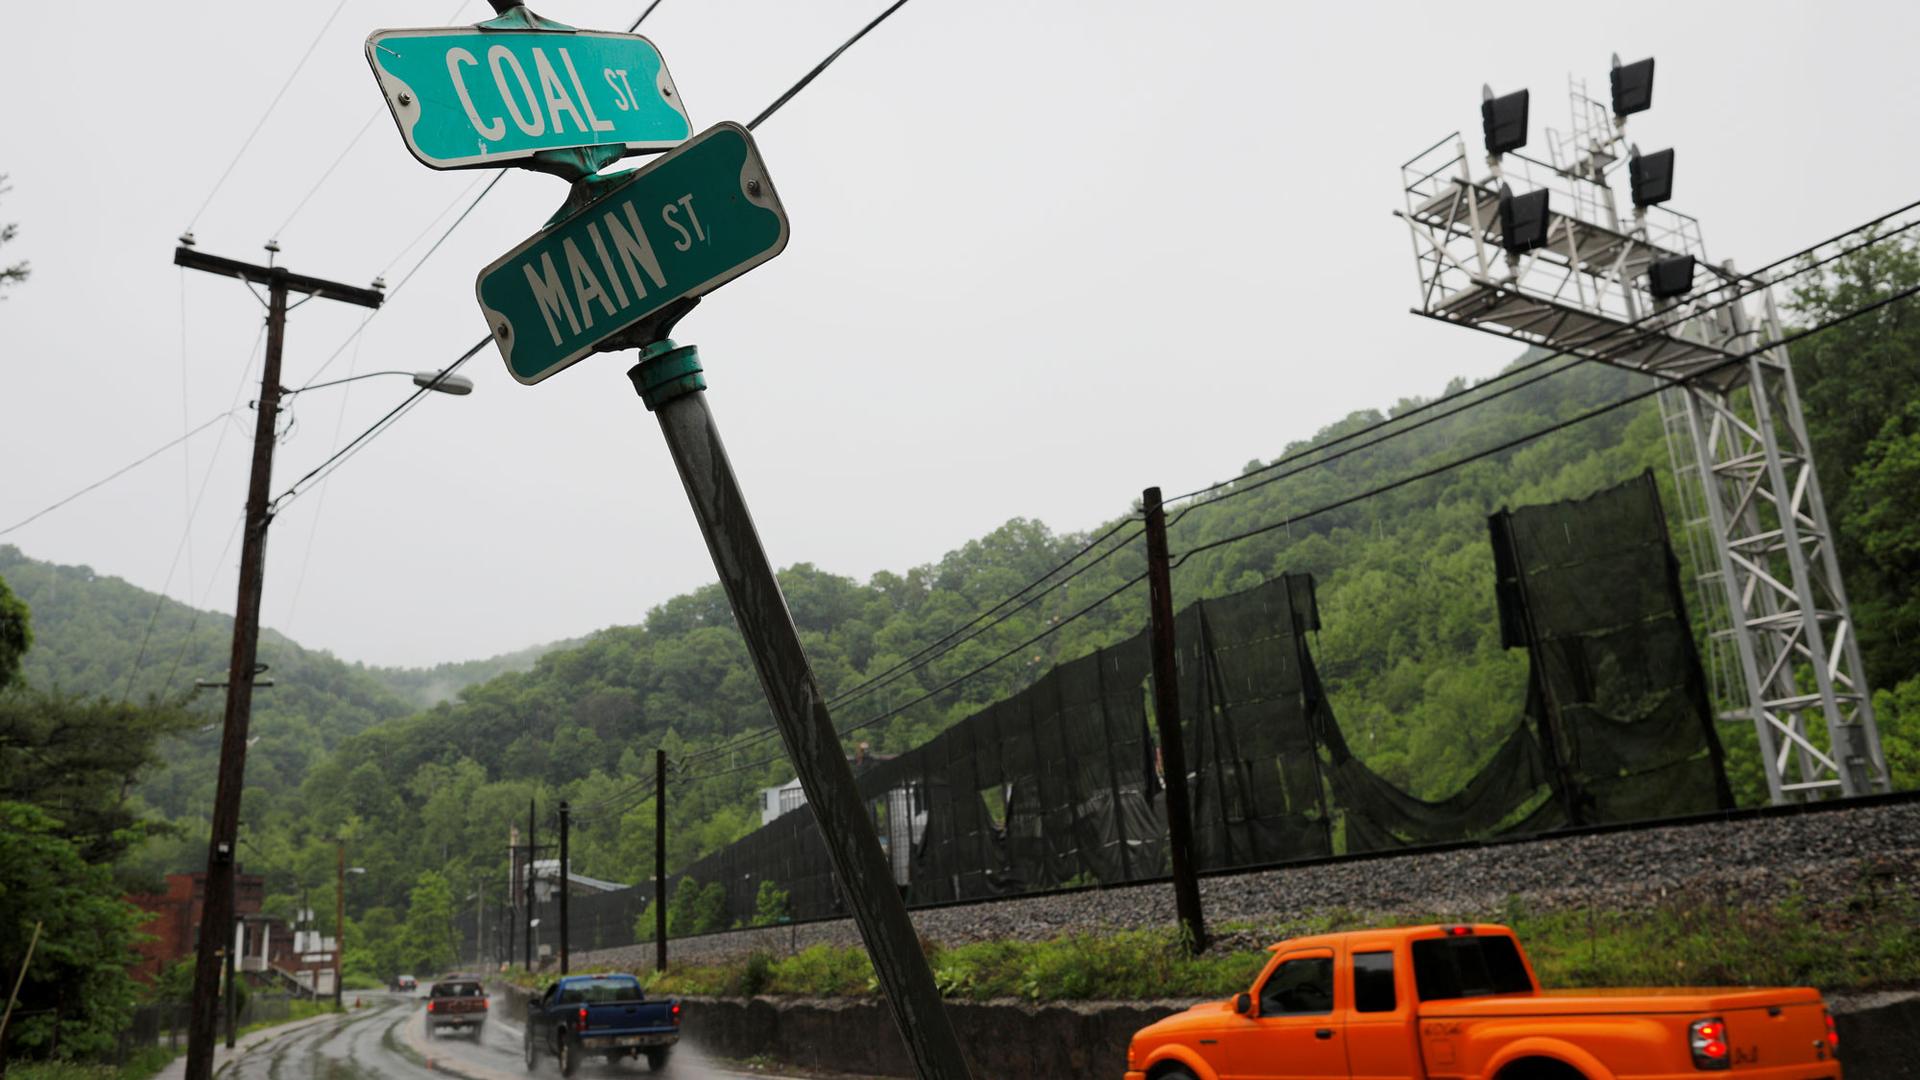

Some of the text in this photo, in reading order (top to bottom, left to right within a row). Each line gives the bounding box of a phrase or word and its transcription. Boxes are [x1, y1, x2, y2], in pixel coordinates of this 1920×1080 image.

[446, 45, 640, 142] COAL ST
[522, 193, 706, 347] MAIN ST
